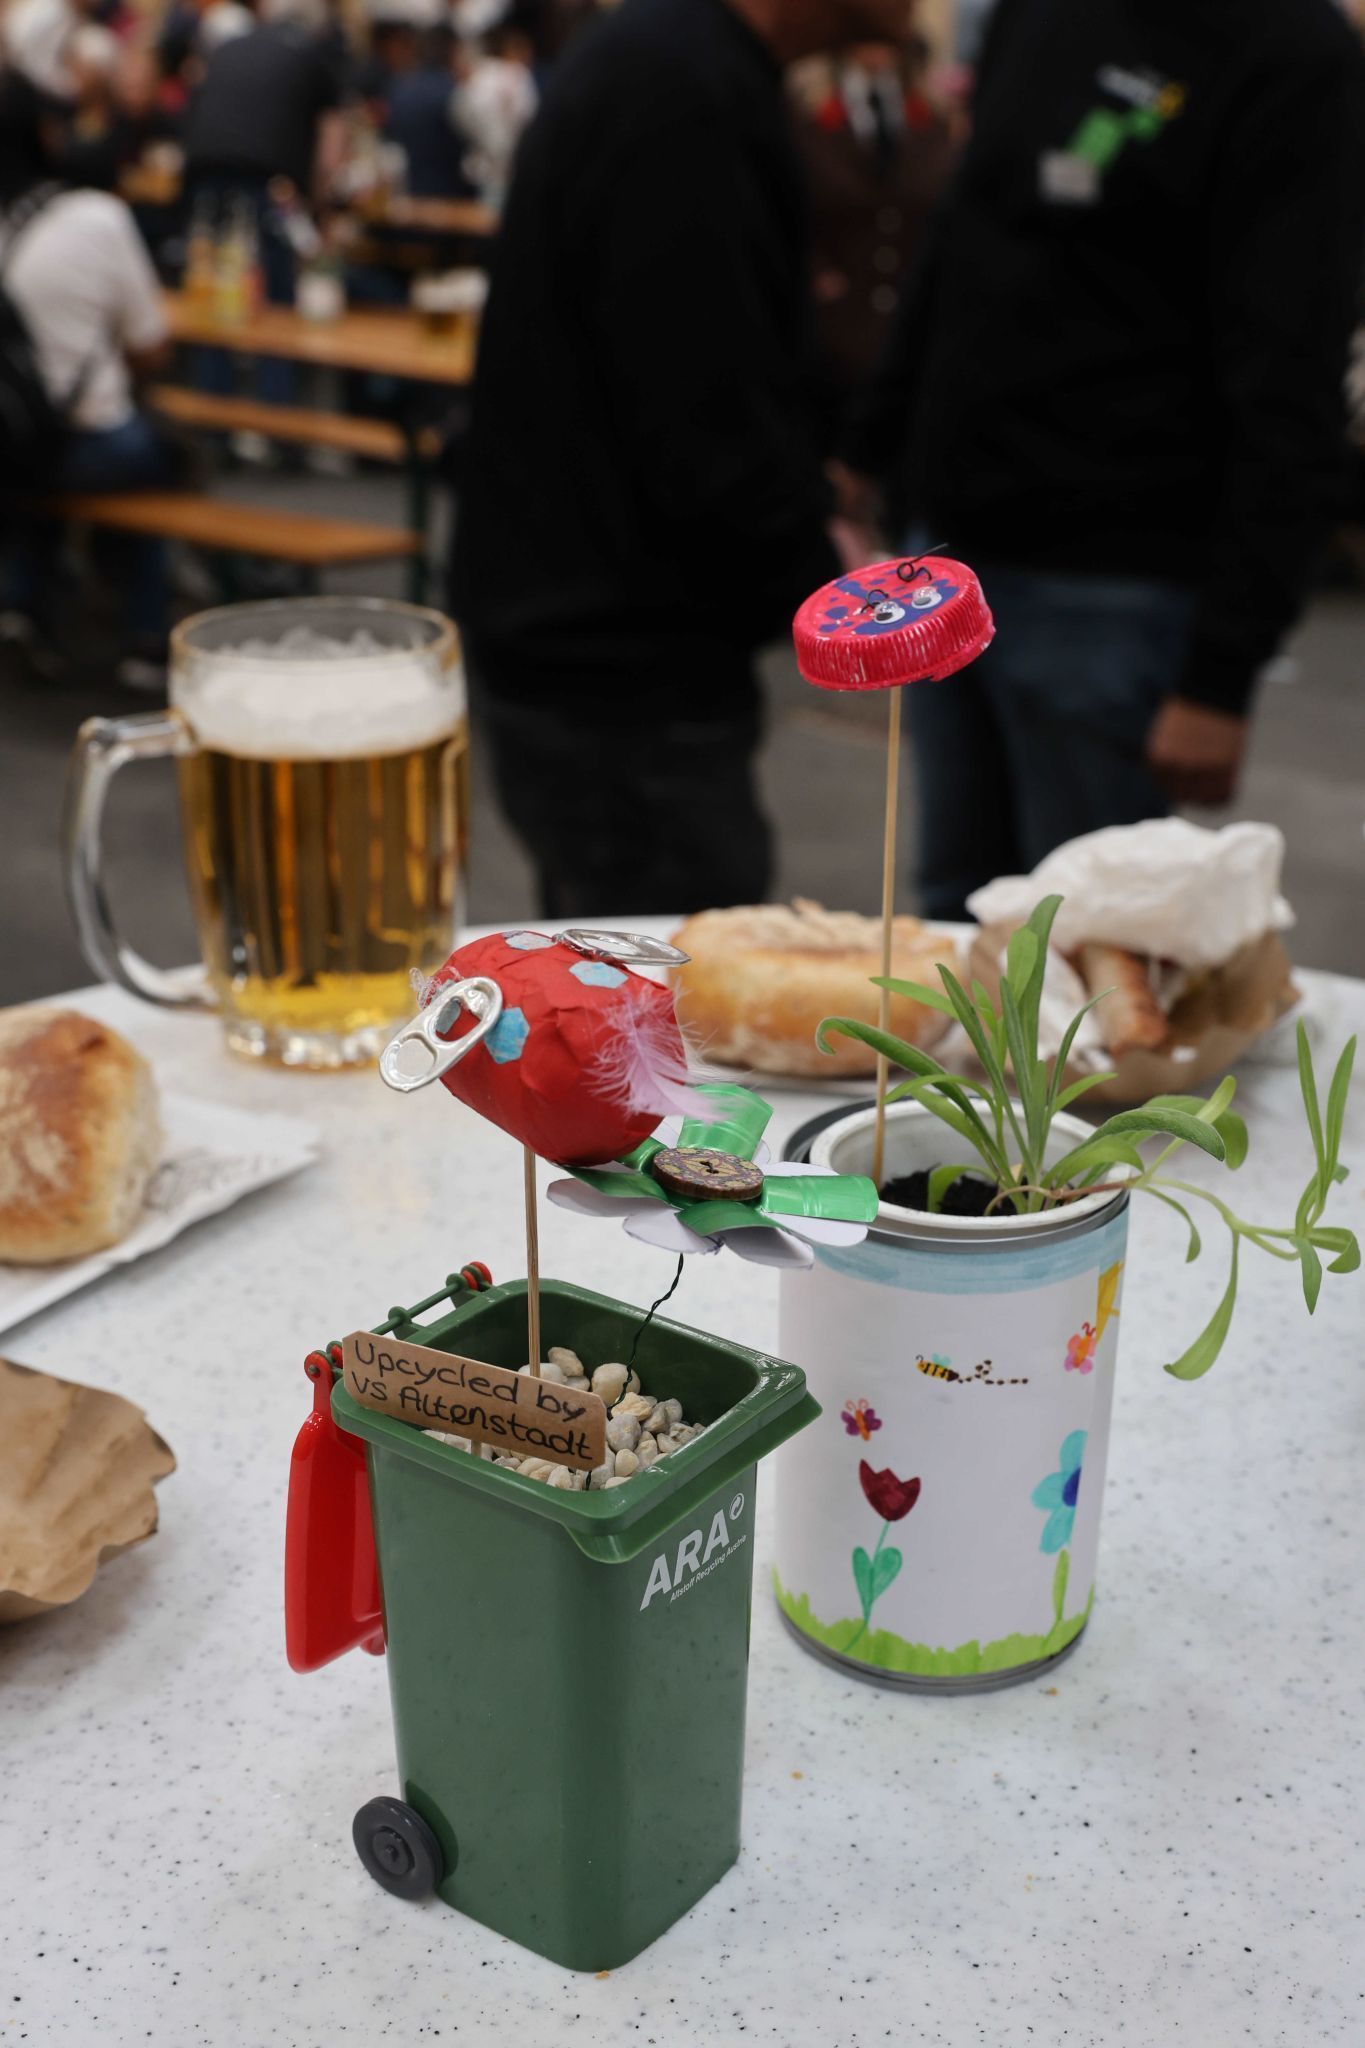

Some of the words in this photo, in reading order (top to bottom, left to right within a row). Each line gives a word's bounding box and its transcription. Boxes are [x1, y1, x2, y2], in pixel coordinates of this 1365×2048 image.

[355, 1339, 519, 1404] Upcycled
[537, 1384, 587, 1422] by
[398, 1386, 593, 1460] Altenstadt
[640, 1508, 730, 1611] ARA
[695, 1553, 726, 1583] Recycling
